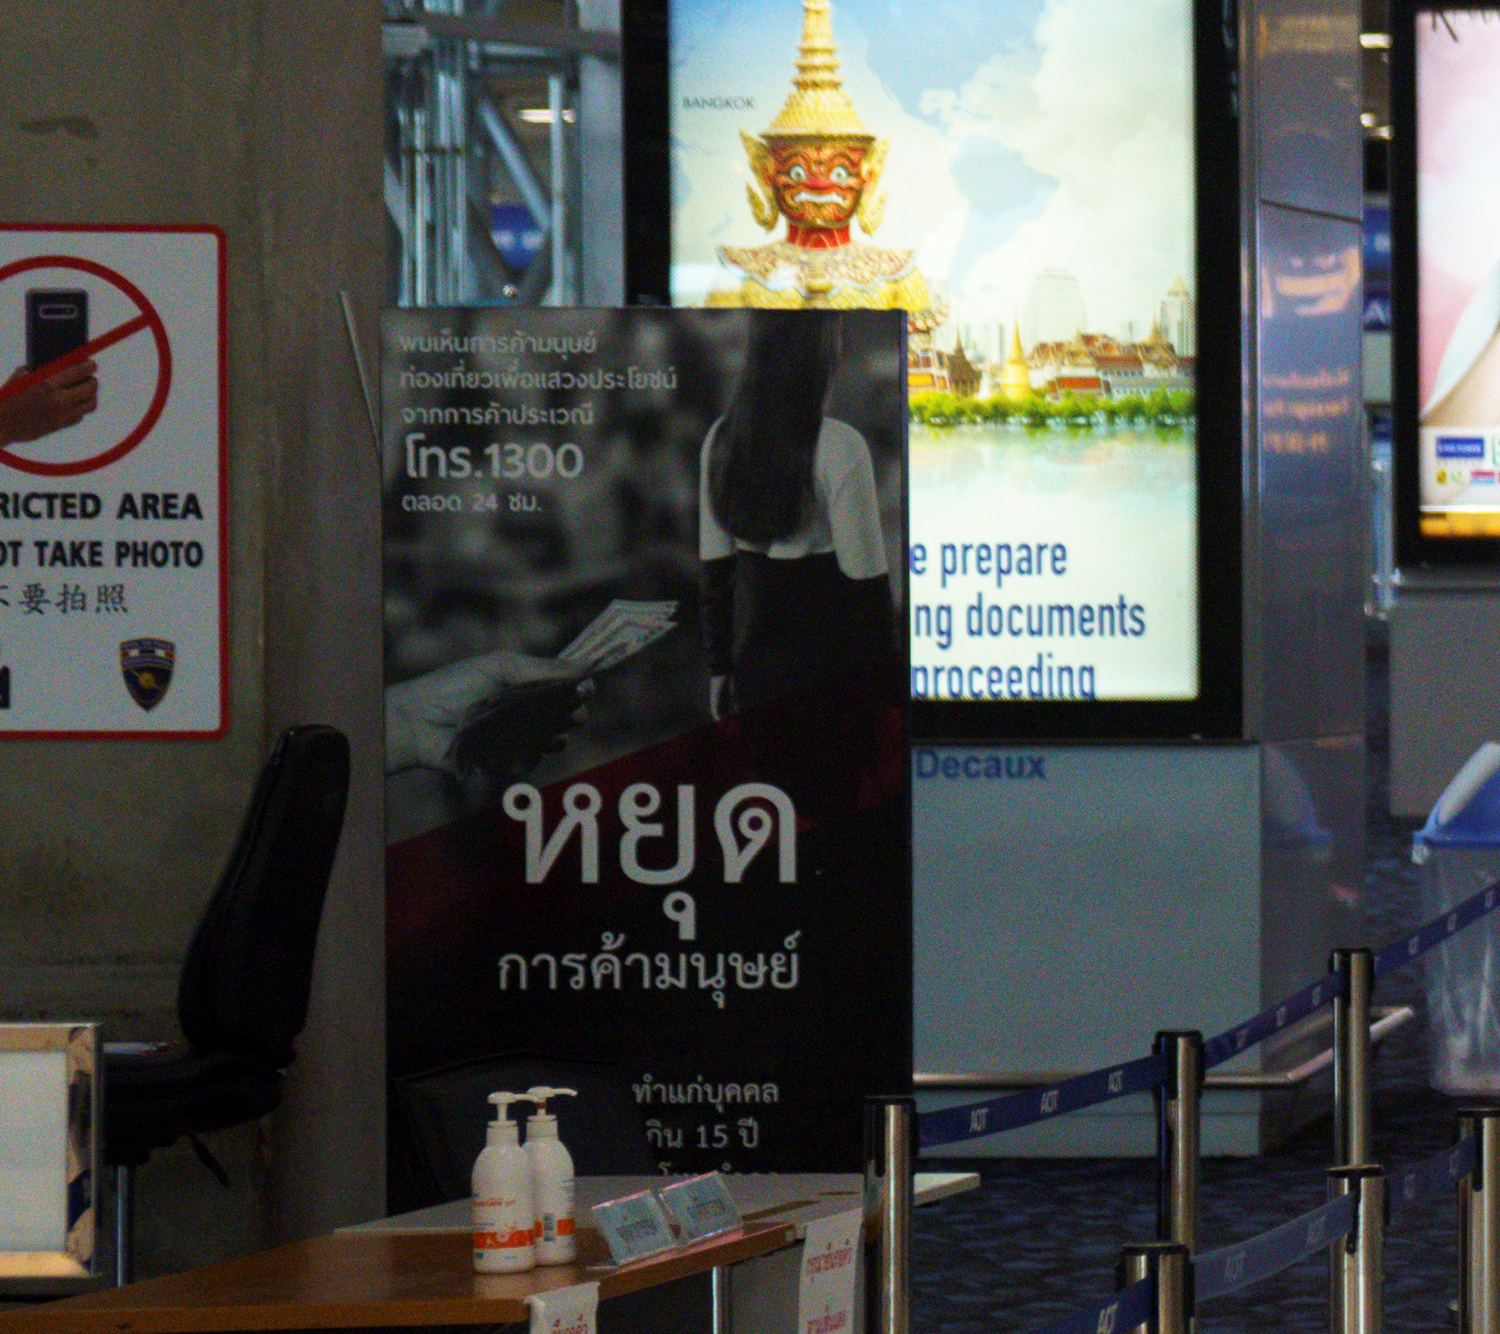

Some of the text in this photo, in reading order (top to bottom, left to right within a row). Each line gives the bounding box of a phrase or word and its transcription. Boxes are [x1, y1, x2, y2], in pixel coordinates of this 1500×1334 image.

[682, 96, 755, 110] BANGKOK
[404, 432, 585, 480] โทร.1300
[116, 492, 203, 520] AREA
[33, 540, 103, 568] TAKE
[115, 540, 204, 569] PHOTO
[940, 542, 1068, 588] prepare
[966, 592, 1147, 638] documents
[501, 781, 799, 940] หยุด
[497, 931, 802, 1009] การค้ามนุษย์
[696, 1123, 729, 1149] 15
[737, 1115, 761, 1149] ปี
